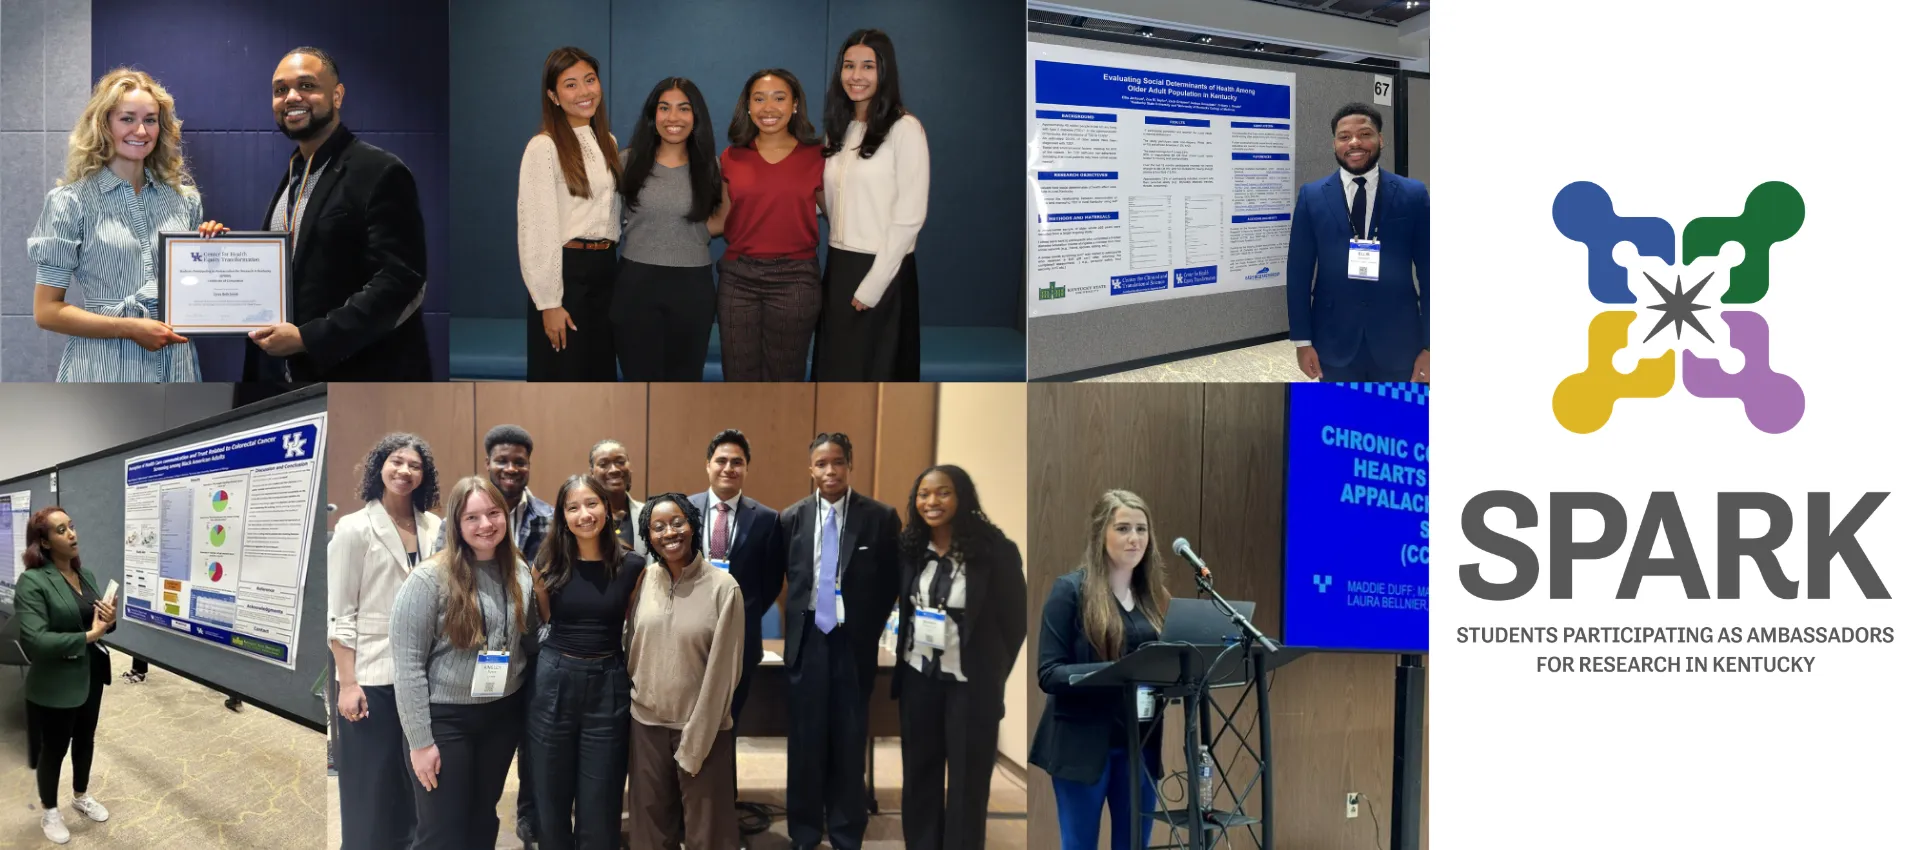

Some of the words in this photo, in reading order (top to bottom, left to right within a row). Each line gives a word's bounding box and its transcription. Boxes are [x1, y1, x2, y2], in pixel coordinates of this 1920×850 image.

[1103, 73, 1142, 85] Evaluating
[1143, 77, 1164, 86] Social
[1165, 79, 1208, 90] Determinants
[1236, 87, 1256, 96] Among
[1375, 81, 1390, 96] 67
[1127, 85, 1146, 93] Older
[1148, 86, 1166, 95] Adult
[1168, 88, 1202, 98] Population
[1210, 93, 1238, 102] Kentucky
[190, 252, 203, 262] UK
[208, 446, 225, 455] Related
[231, 440, 256, 451] Colorectal
[257, 436, 276, 445] Cancer
[282, 431, 307, 459] UK
[1321, 425, 1408, 459] CHRONIC
[284, 461, 309, 470] Conclusion
[1353, 457, 1427, 488] HEARTS
[1347, 580, 1386, 595] MADDIE
[1347, 594, 1380, 608] LAURA
